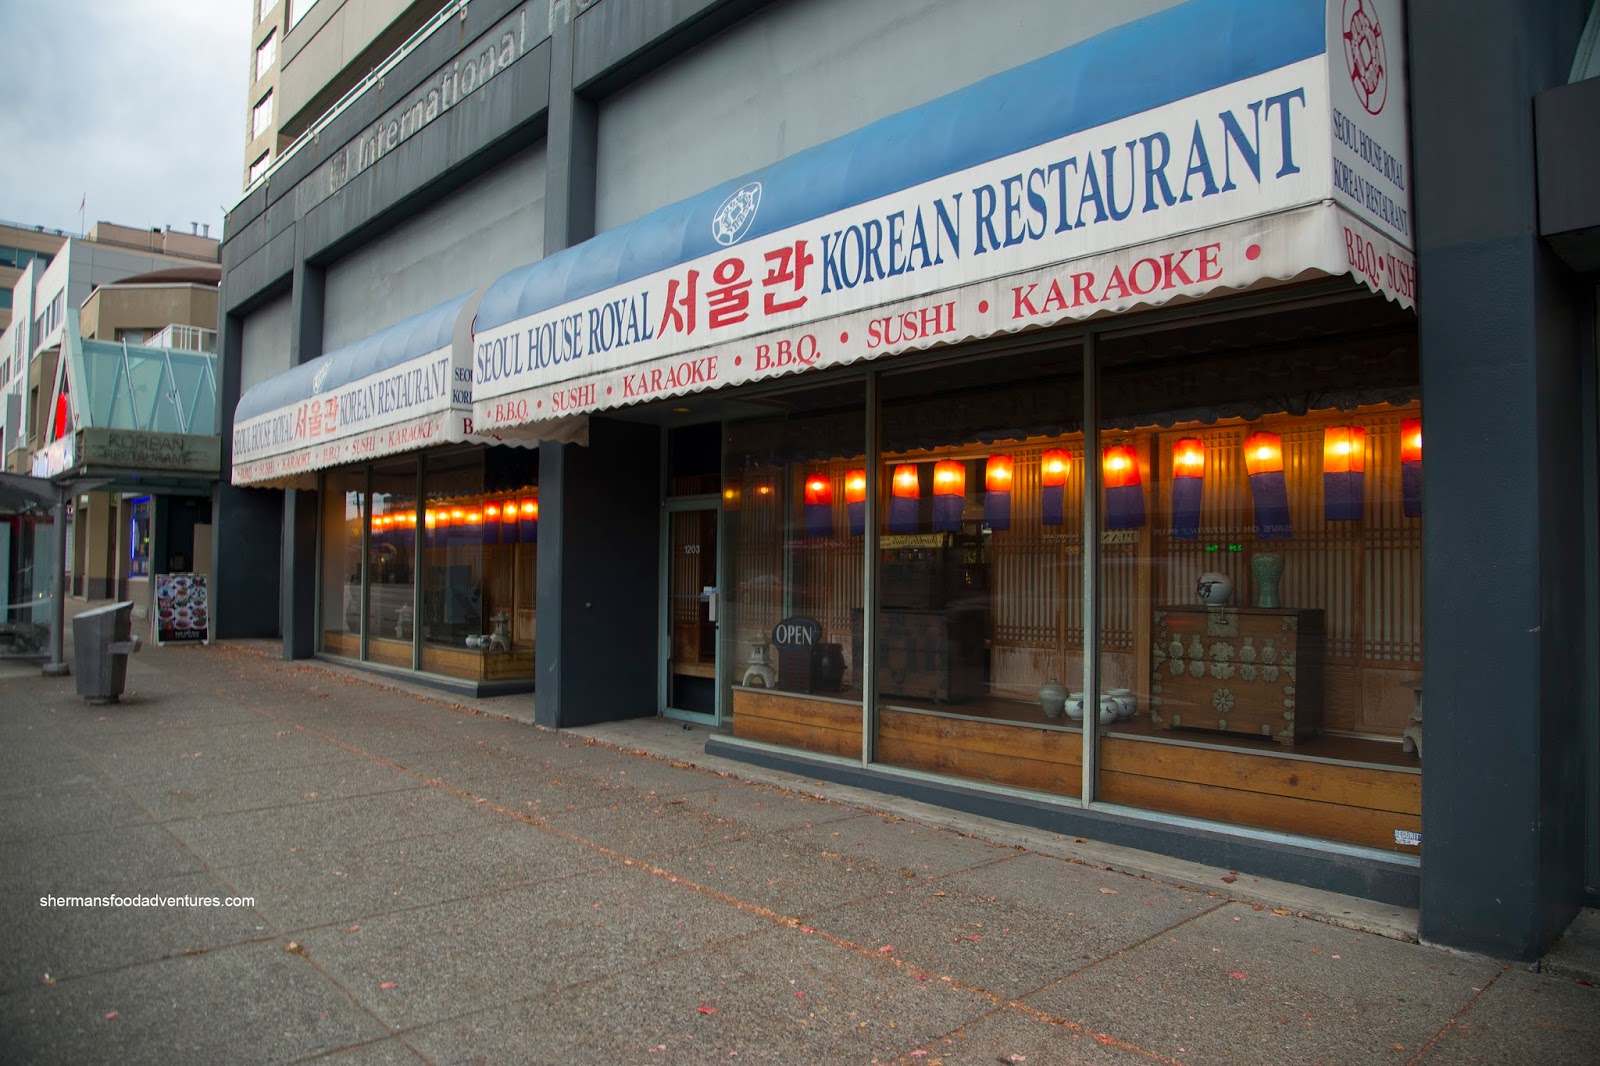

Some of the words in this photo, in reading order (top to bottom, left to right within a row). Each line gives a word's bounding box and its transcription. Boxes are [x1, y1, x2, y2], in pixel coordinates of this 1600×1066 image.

[358, 10, 526, 174] International
[1333, 108, 1358, 154] SEOUL
[1359, 130, 1383, 173] HOUSE
[1384, 150, 1405, 191] ROYAL
[1333, 156, 1366, 204] KOREAN
[1366, 179, 1409, 236] RESTAURANT
[476, 331, 524, 385] SEOUL
[527, 311, 583, 372] HOUSE
[588, 291, 654, 356] ROYAL
[657, 240, 815, 340] 서울관
[821, 191, 963, 296] KOREAN
[972, 87, 1306, 256] RESTAURANT
[1386, 252, 1416, 300] SUSH
[494, 398, 529, 424] B.B.Q.
[551, 383, 597, 413] SUSHI
[622, 355, 719, 399] KARAOKE
[754, 334, 821, 372] B.B.Q.
[866, 301, 957, 350] SUSHI
[1011, 242, 1224, 320] KARAOKE
[455, 366, 473, 382] SEO
[234, 427, 251, 456] SEOUL
[252, 420, 272, 451] HOUSE
[272, 413, 294, 446] ROYAL
[294, 396, 339, 440] 서울관
[340, 384, 377, 427] KOREAN
[378, 358, 449, 415] RESTAURANT
[351, 435, 377, 455] SUSHI
[388, 420, 434, 448] KARAOKE
[109, 433, 184, 452] KOREAN
[684, 544, 701, 555] 1203
[775, 624, 812, 646] OPEN
